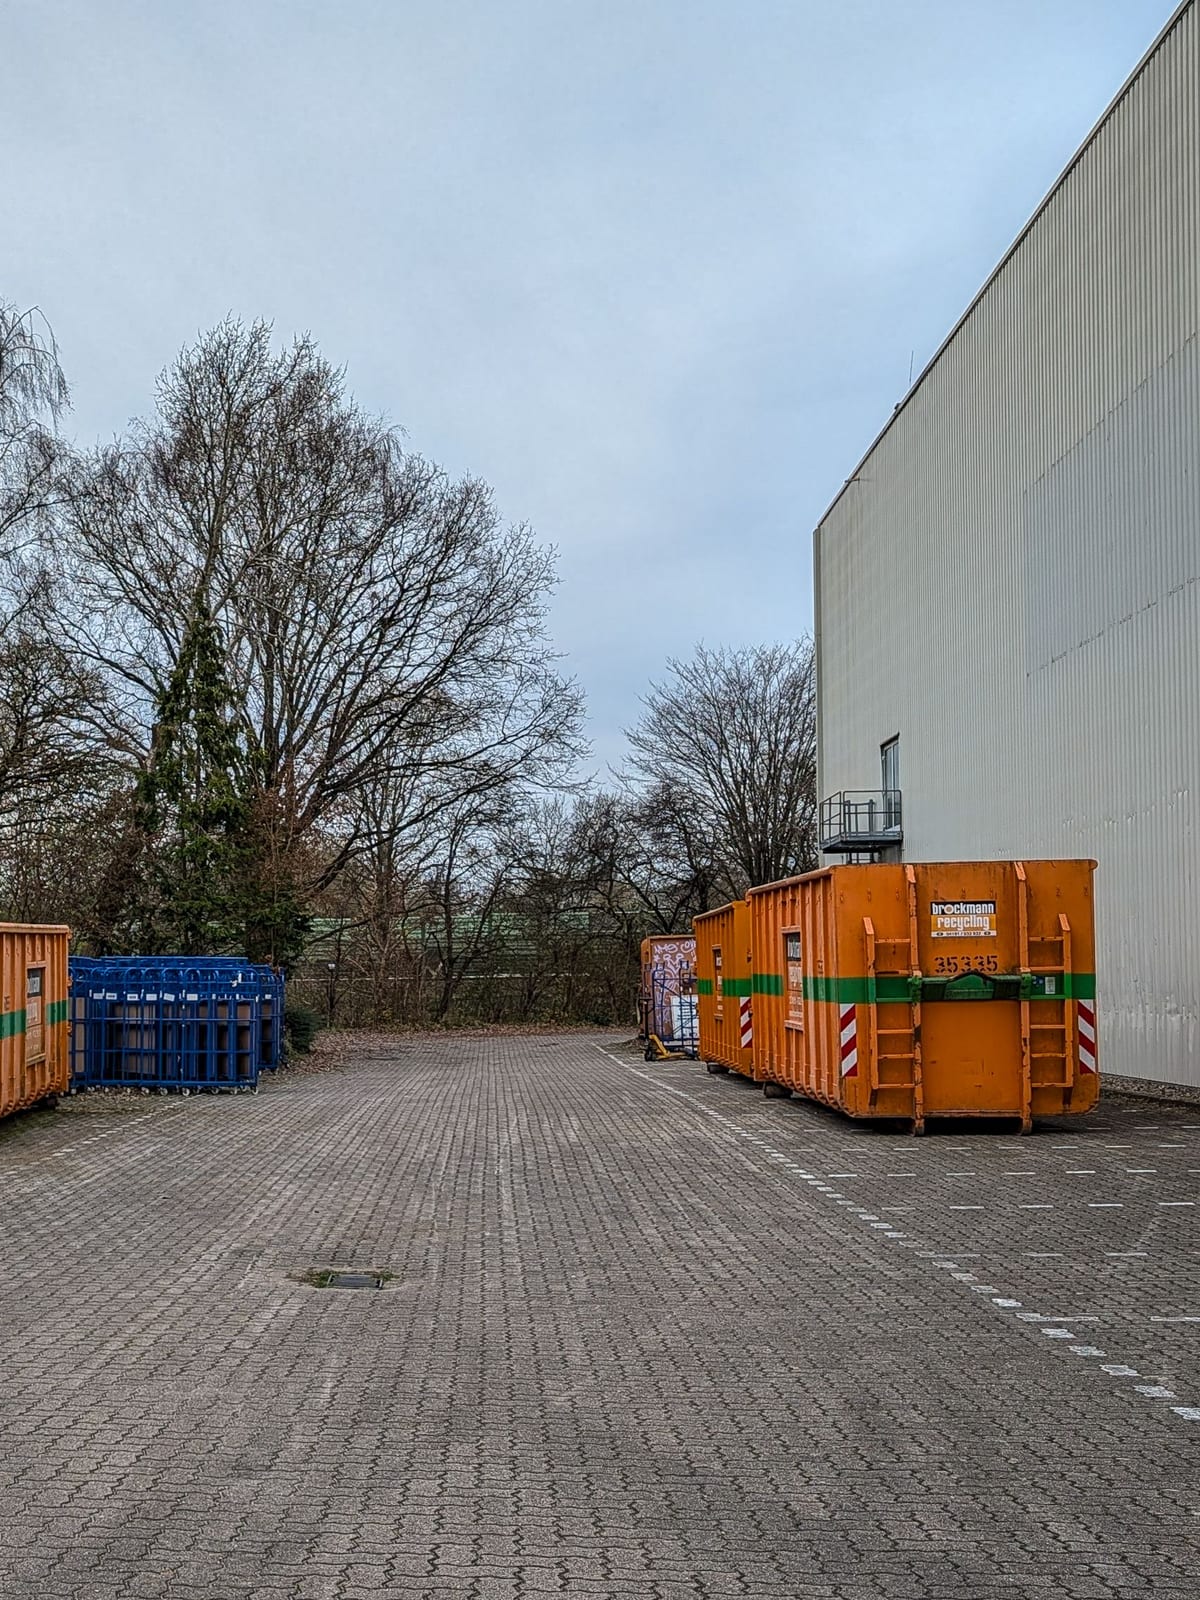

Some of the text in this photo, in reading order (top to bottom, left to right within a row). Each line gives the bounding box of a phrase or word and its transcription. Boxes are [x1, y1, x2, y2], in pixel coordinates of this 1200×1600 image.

[932, 903, 995, 915] brockmann
[937, 914, 990, 931] recycling
[934, 955, 998, 973] 35335
